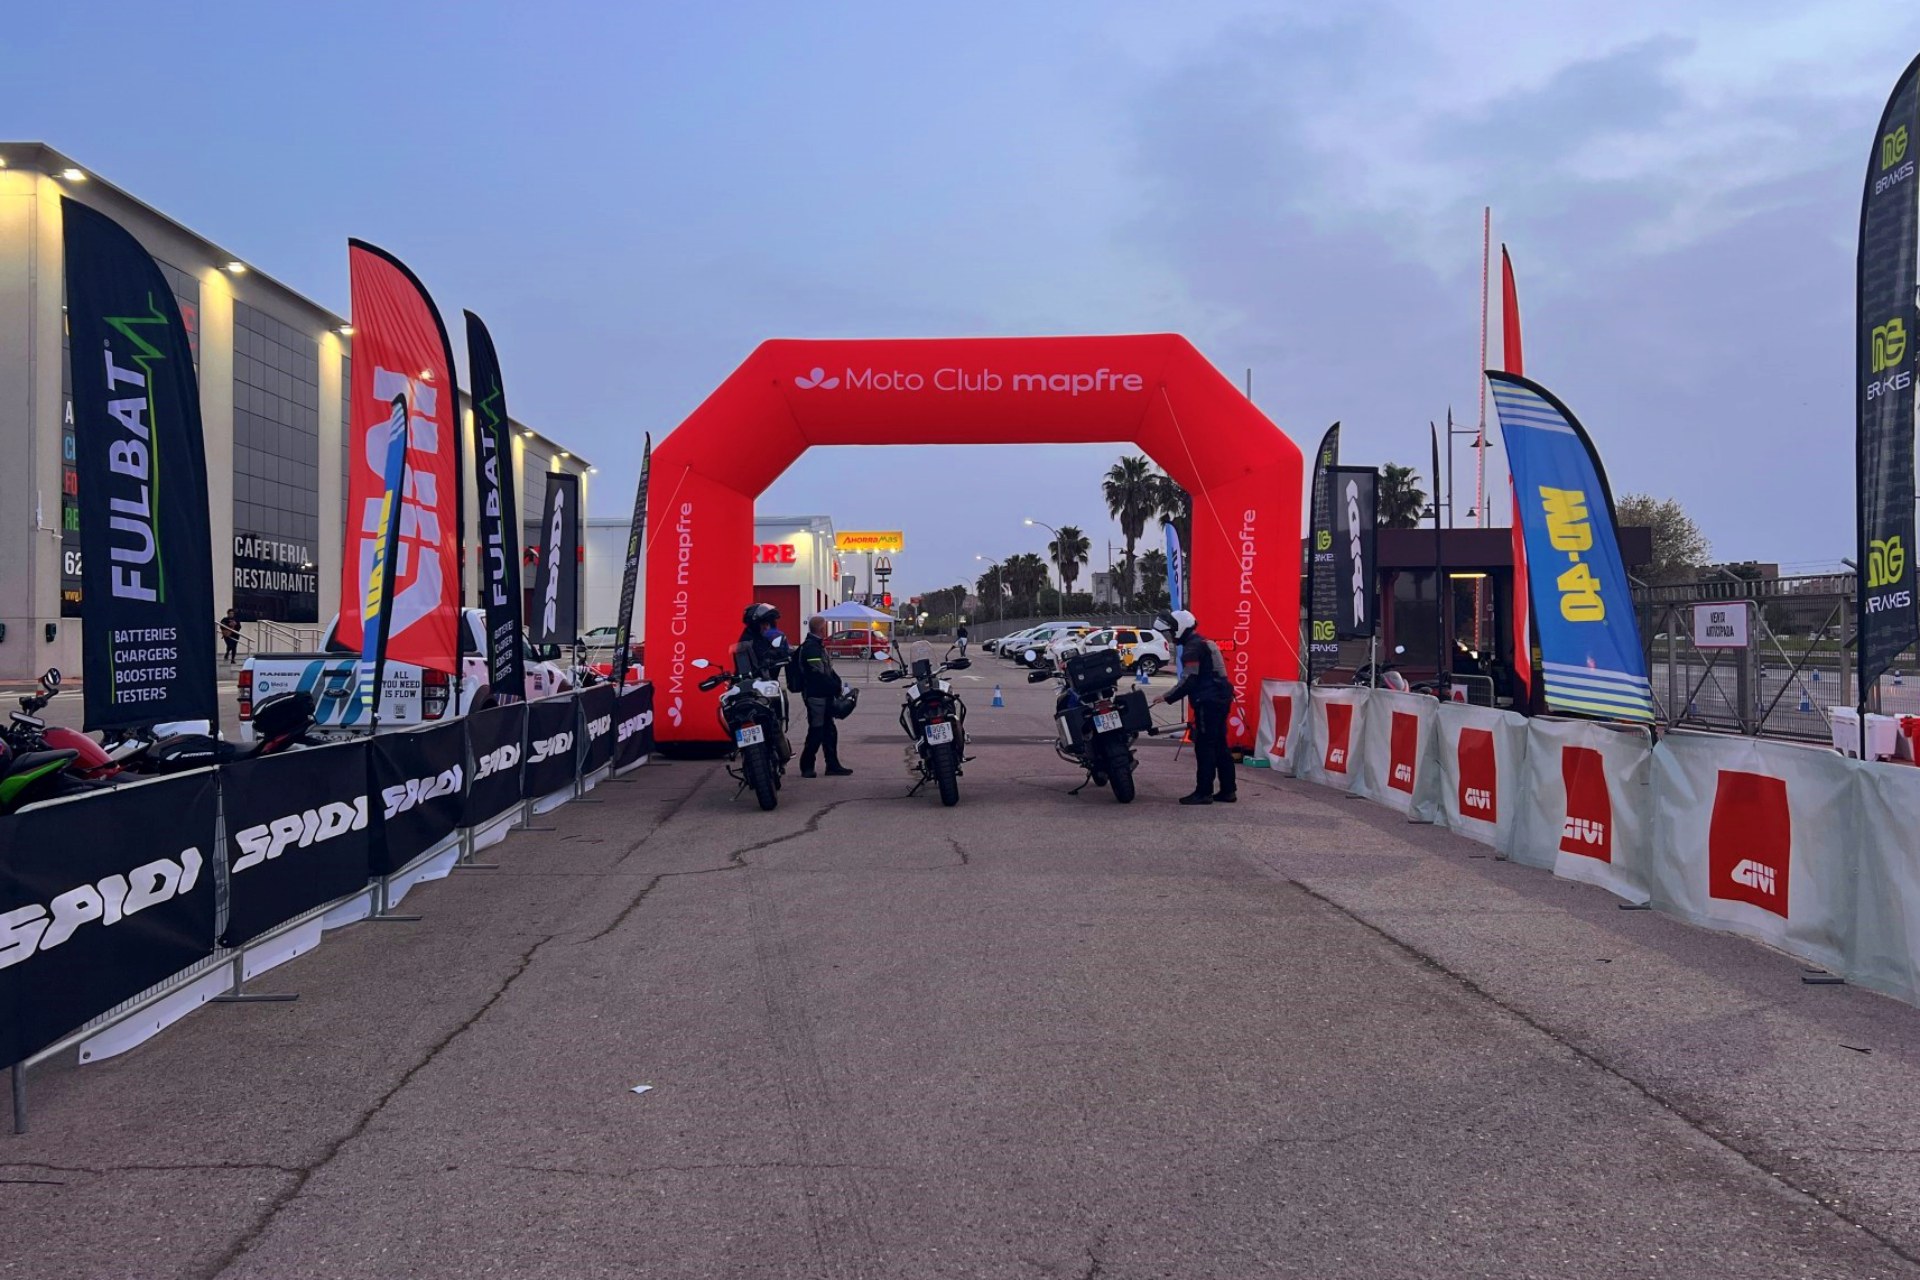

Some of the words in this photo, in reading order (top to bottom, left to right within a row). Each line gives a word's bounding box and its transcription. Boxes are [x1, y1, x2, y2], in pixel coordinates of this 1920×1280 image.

[1875, 160, 1914, 195] BRAKES
[845, 368, 924, 391] Moto
[933, 368, 1003, 391] Club
[1012, 368, 1143, 396] mapfre
[104, 349, 156, 602] FULBAT
[480, 419, 508, 606] FULBAT
[234, 536, 308, 564] CAFETERIA
[676, 502, 693, 585] mapfre
[1239, 509, 1257, 594] mapfre
[234, 567, 316, 593] RESTAURANTE
[671, 591, 688, 636] Club
[1233, 600, 1250, 646] Club
[114, 627, 177, 643] BATTERIES
[114, 647, 178, 663] CHARGERS
[669, 641, 686, 693] Moto
[115, 666, 177, 683] BOOSTERS
[382, 680, 397, 688] YOU
[400, 680, 420, 688] NEED
[394, 671, 409, 679] ALL
[1233, 652, 1249, 703] Moto
[116, 686, 167, 704] TESTERS
[385, 690, 392, 698] IS
[394, 690, 416, 698] FLOW
[617, 710, 653, 742] SPIDI
[382, 763, 463, 821] SPIDI
[1465, 787, 1491, 810] GIVI
[232, 795, 368, 873] SPIDI
[1561, 816, 1604, 845] GIVI
[1730, 859, 1776, 895] GIVI
[0, 847, 203, 969] SPIDI
